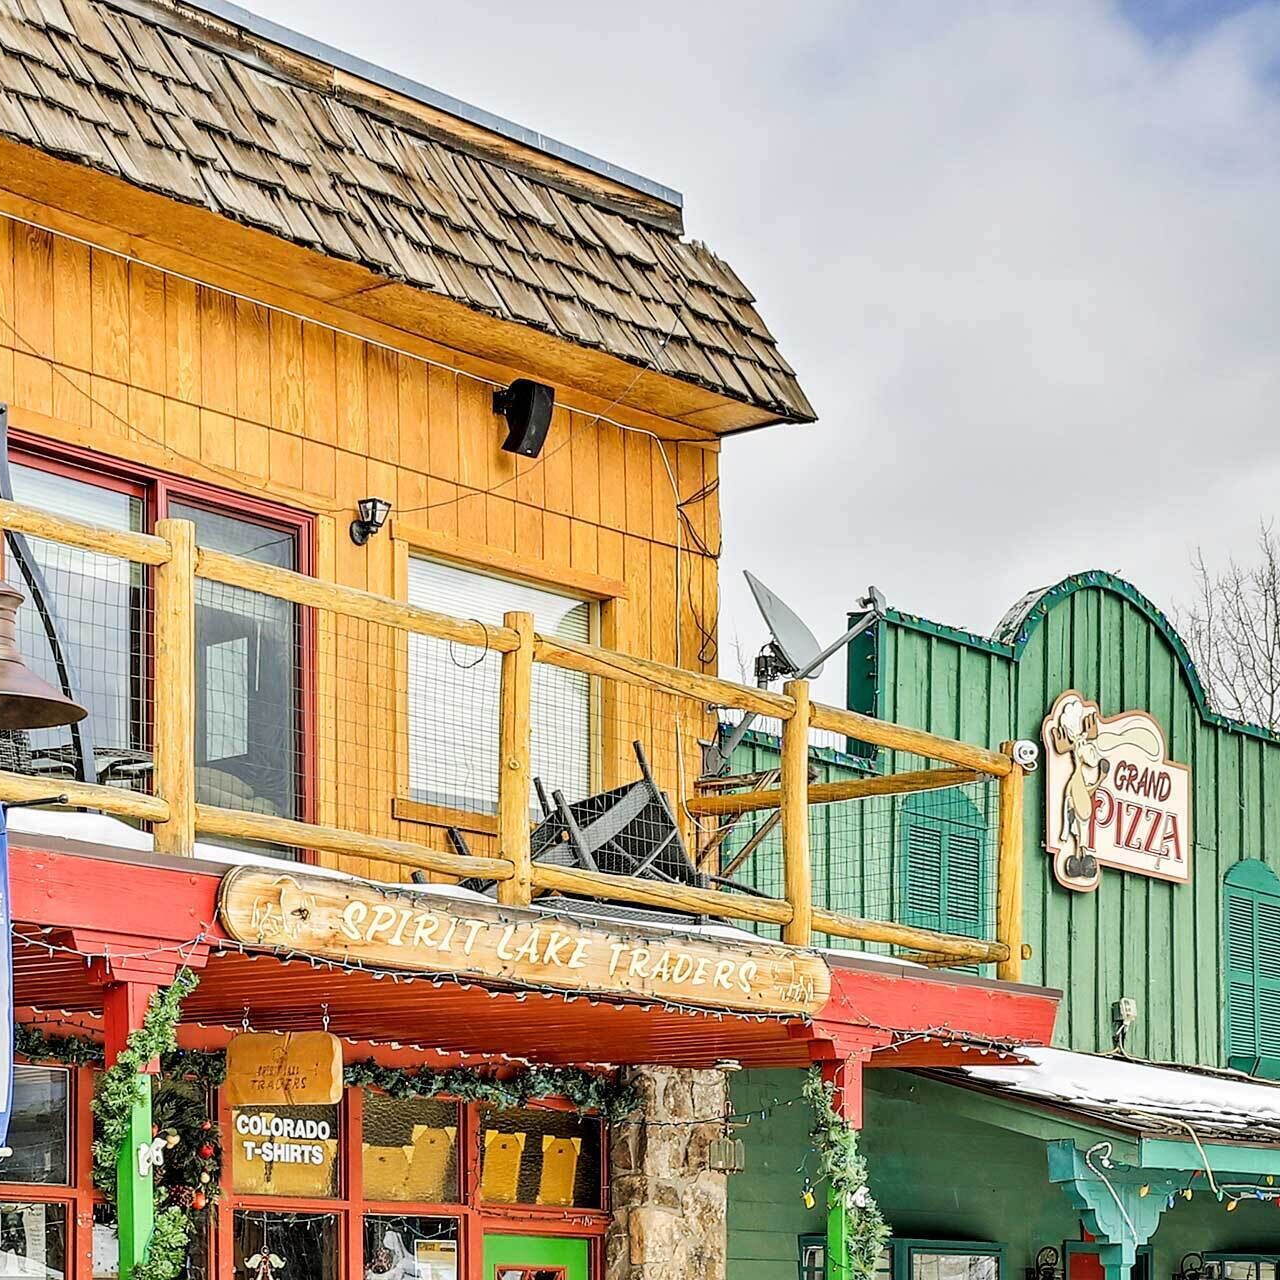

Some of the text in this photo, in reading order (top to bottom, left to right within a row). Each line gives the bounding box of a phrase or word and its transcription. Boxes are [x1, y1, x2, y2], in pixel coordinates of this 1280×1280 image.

[1114, 760, 1170, 802] GRAND
[1087, 786, 1183, 866] PIZZA
[340, 900, 759, 993] SPIRIT LAKE TRADERS
[251, 1076, 308, 1091] TRADERS
[236, 1114, 331, 1140] COLORADO
[243, 1140, 324, 1165] T-SHIRTS
